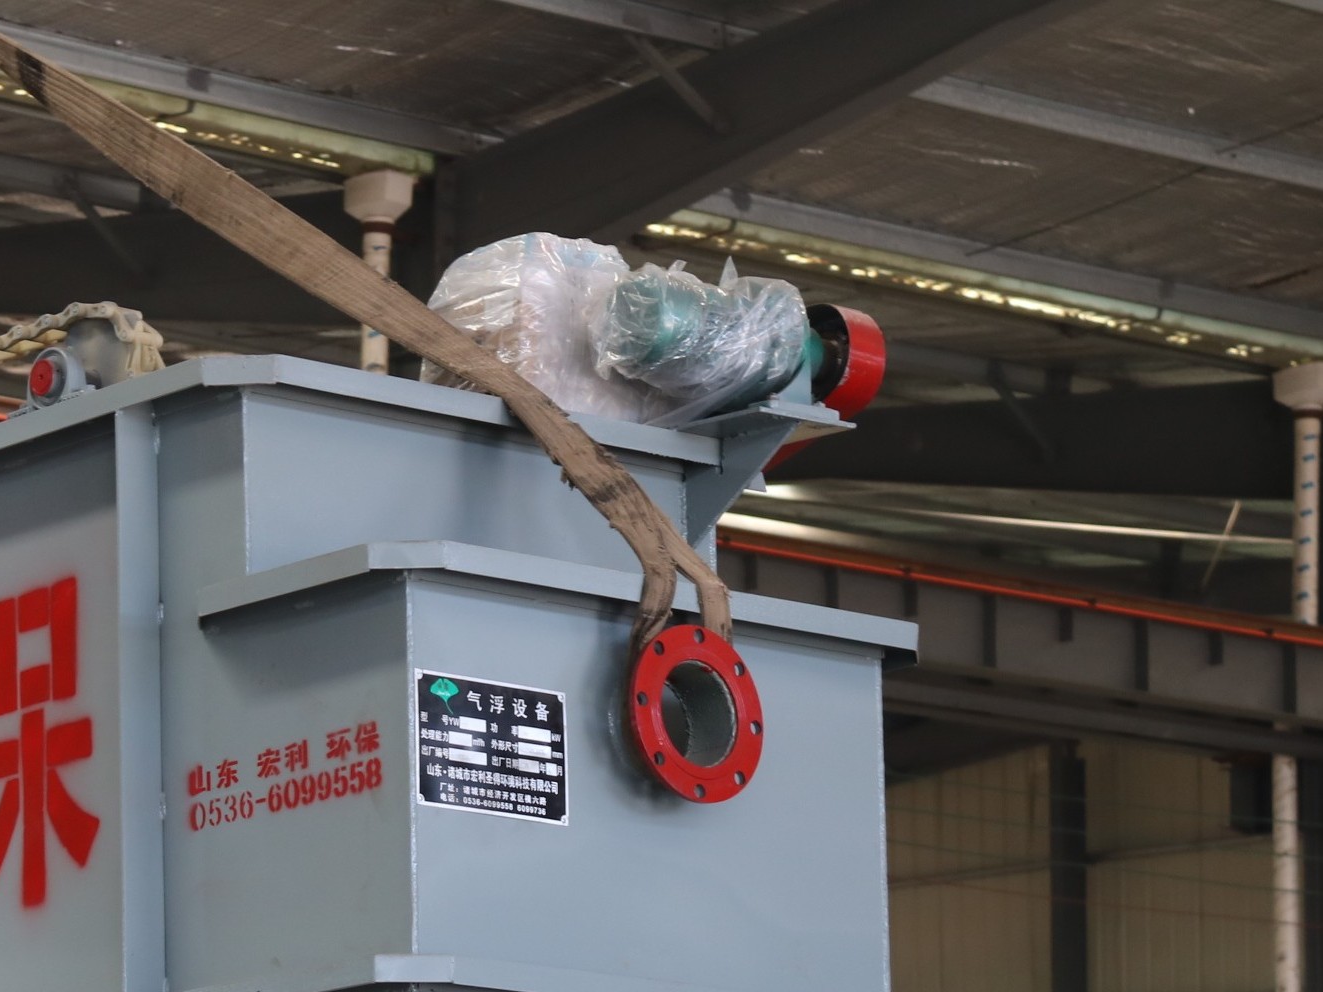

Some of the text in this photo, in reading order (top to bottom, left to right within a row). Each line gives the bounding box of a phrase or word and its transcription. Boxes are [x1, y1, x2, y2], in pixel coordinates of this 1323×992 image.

[466, 690, 549, 722] 气浮设备
[188, 721, 380, 796] 山东 宏利 环保
[491, 739, 518, 754] 外形尺寸
[491, 755, 519, 770] 出厂日期
[189, 758, 382, 831] 0536-6099558
